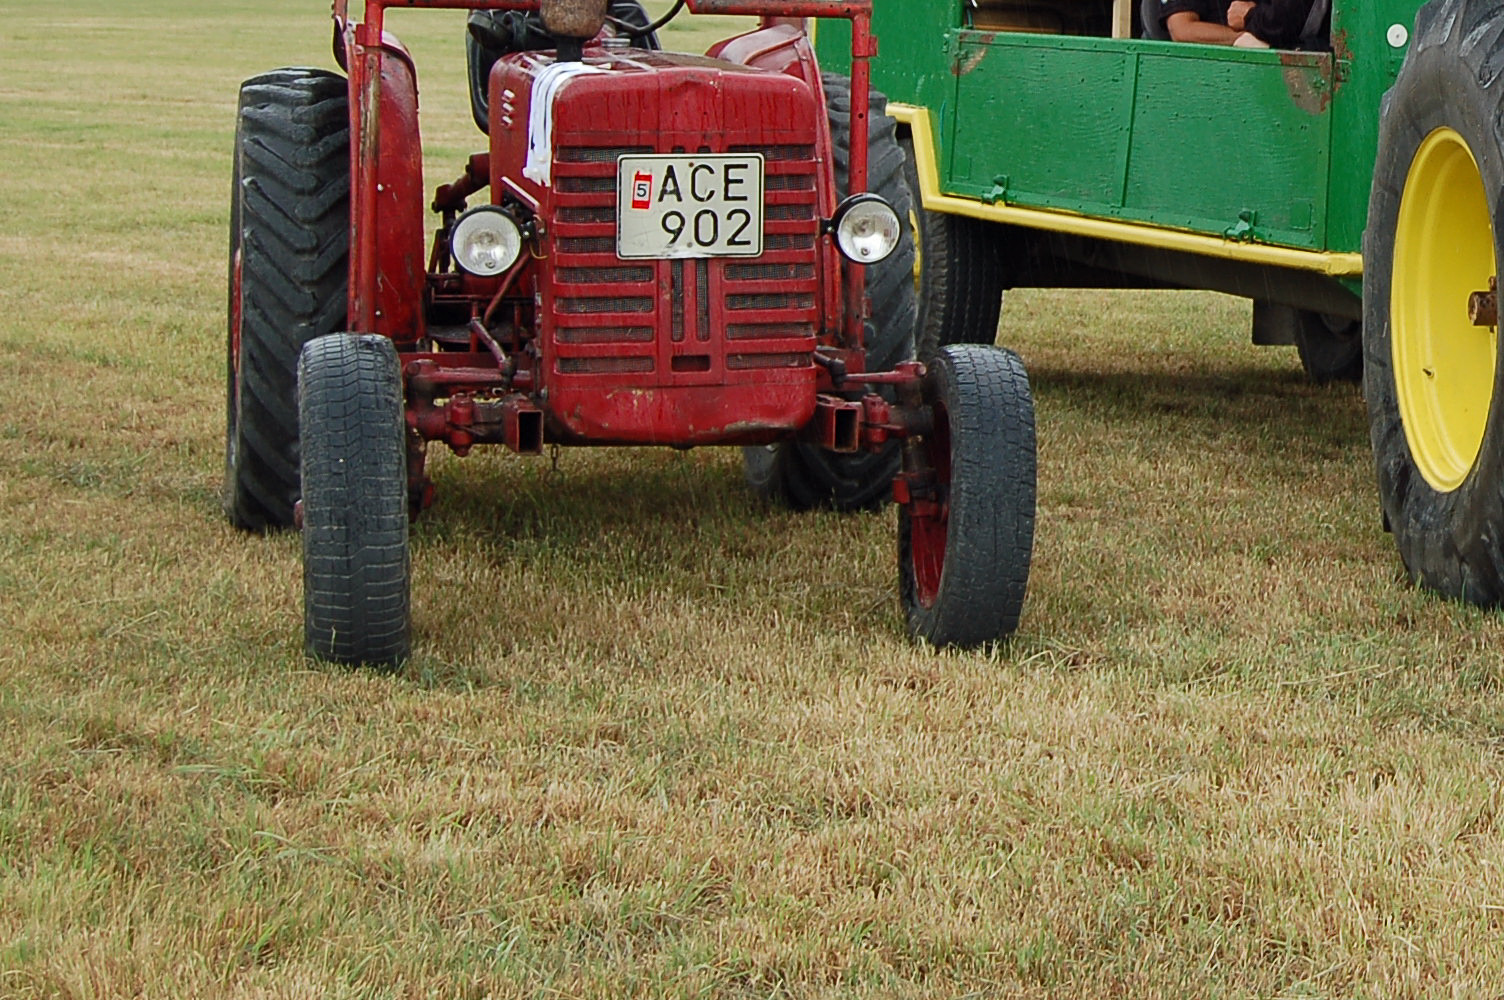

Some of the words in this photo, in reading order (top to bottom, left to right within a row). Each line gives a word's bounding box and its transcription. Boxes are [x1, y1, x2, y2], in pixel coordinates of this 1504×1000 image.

[636, 183, 647, 197] 5
[658, 163, 749, 202] ACE
[661, 208, 752, 247] 902
